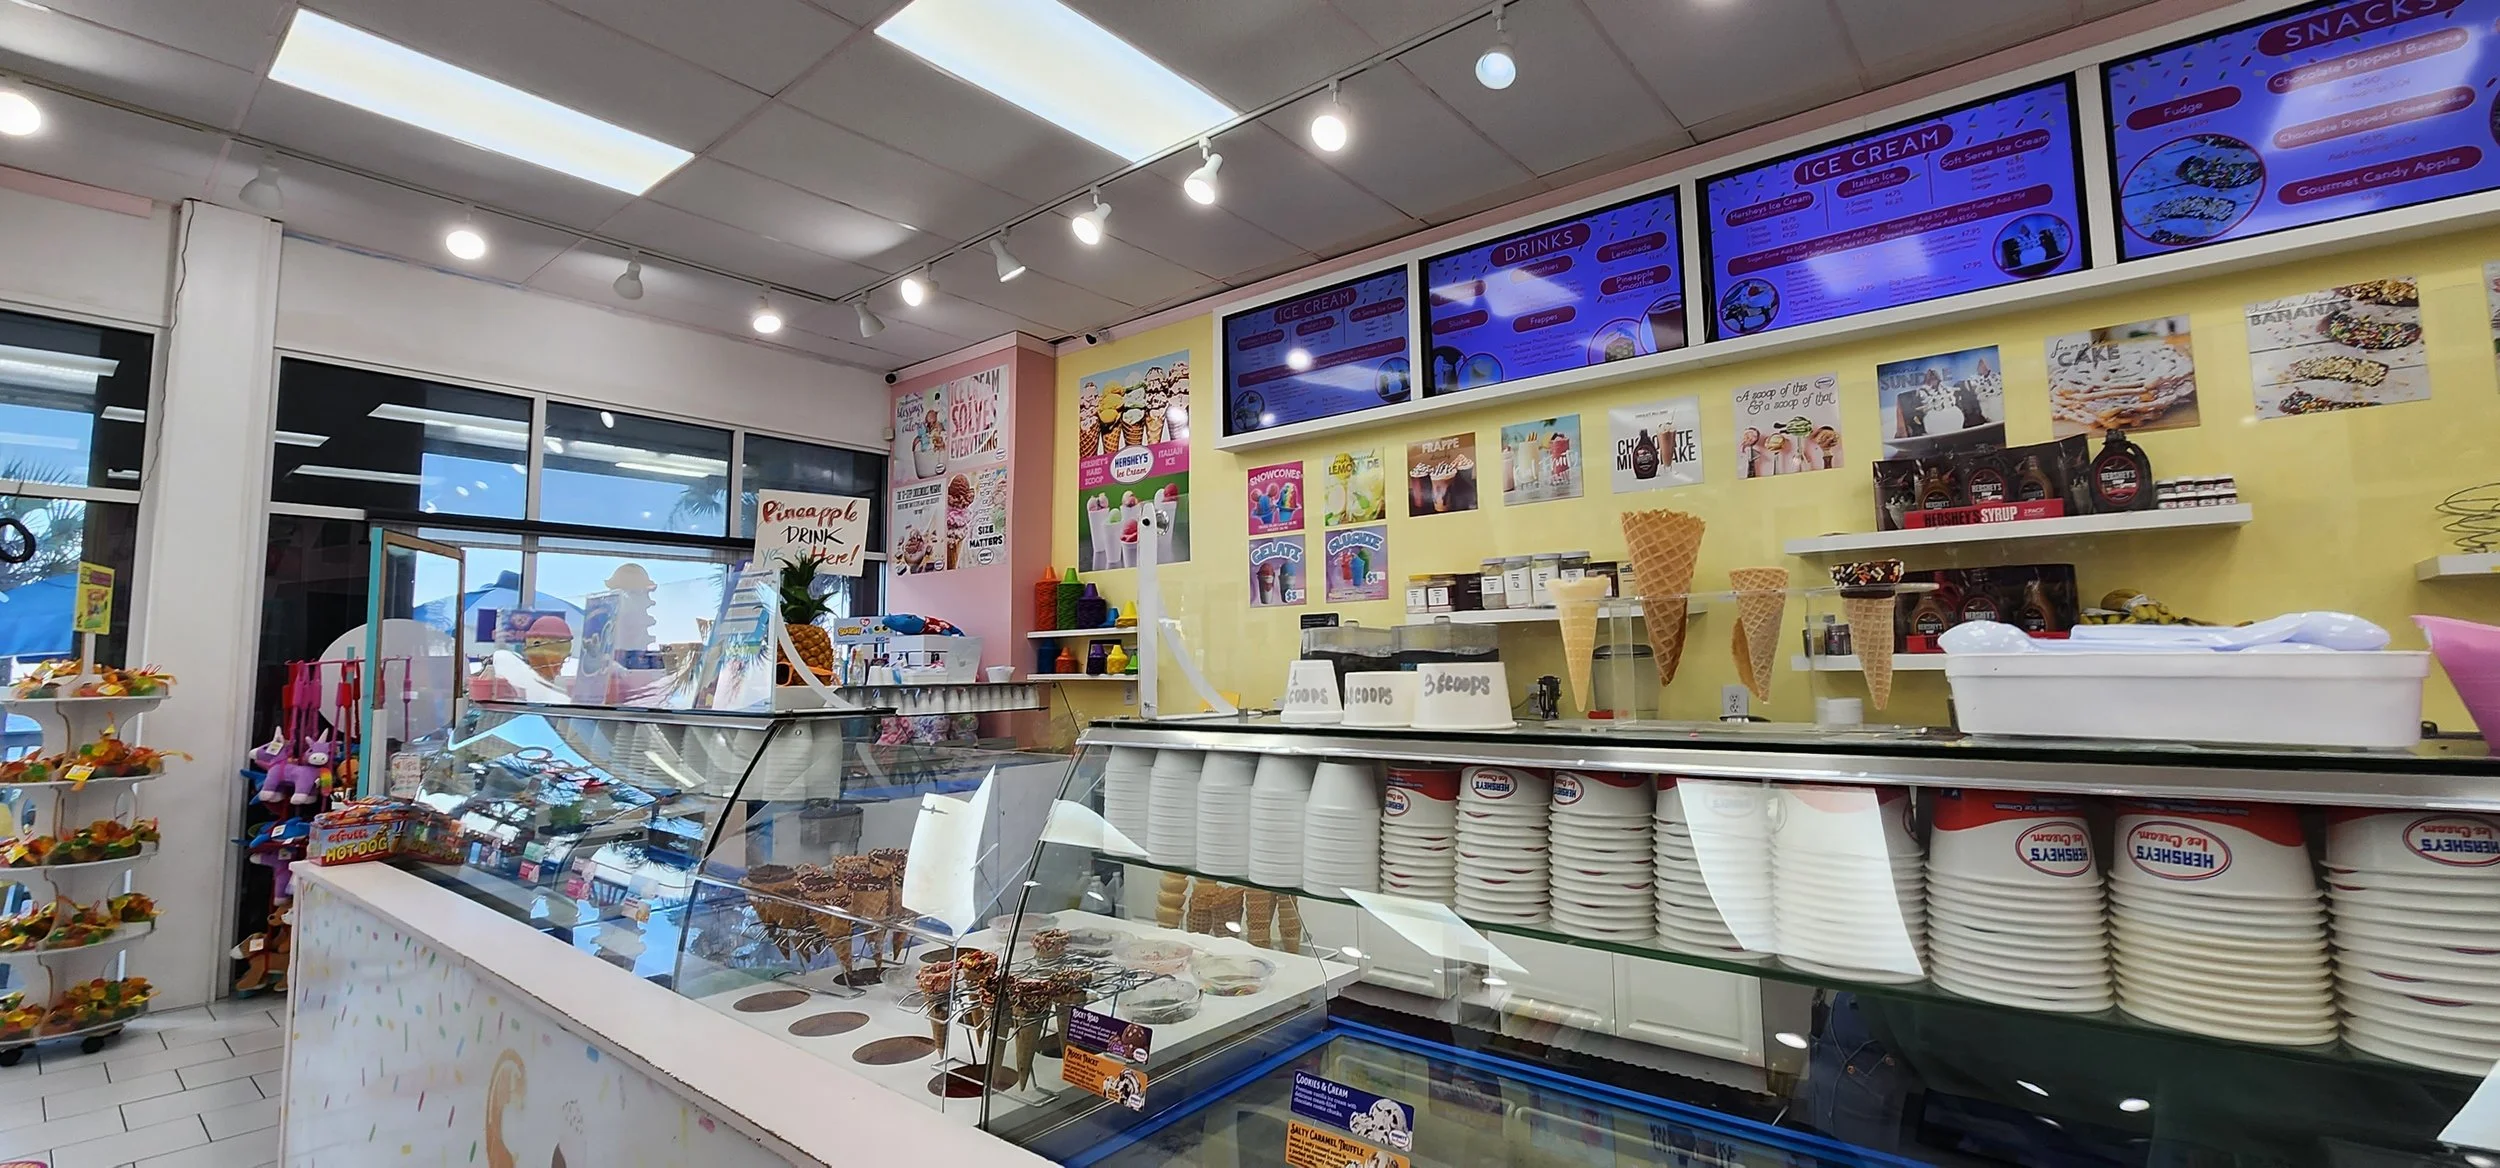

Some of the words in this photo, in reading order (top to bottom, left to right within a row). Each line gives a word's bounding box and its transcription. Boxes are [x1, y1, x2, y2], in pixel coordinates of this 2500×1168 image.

[2274, 64, 2342, 88] Chocolate
[2346, 49, 2402, 70] Dipped
[2164, 103, 2204, 117] Fudge
[2279, 124, 2338, 143] Chocolate
[2341, 111, 2388, 130] Dipped
[1804, 157, 1842, 181] ICE
[1850, 130, 1940, 169] CREAM
[1941, 155, 1962, 168] Soft
[1964, 149, 1993, 163] Serve
[1996, 143, 2012, 154] Ice
[2015, 134, 2049, 149] Cream
[1852, 177, 1880, 189] Italian
[1881, 173, 1896, 184] Ice
[2297, 177, 2359, 197] Gourmet
[2363, 166, 2408, 183] Candy
[2413, 156, 2461, 173] Apple
[1730, 207, 1767, 221] Hersheys
[1768, 200, 1782, 210] Ice
[1783, 193, 1812, 206] Cream
[1505, 230, 1574, 262] DRINKS
[1612, 243, 1652, 259] Lemonade
[1616, 270, 1655, 284] Pineapple
[1617, 279, 1654, 291] Smoothie
[1278, 306, 1299, 321] ICE
[1303, 291, 1350, 314] CREAM
[2250, 300, 2353, 326] BANANAS
[1530, 314, 1559, 326] Frappes
[2058, 344, 2121, 367] CAKE
[1880, 367, 1953, 391] SUNDE
[1736, 390, 1750, 402] A
[1752, 389, 1777, 400] scoop
[1780, 383, 1792, 398] of
[1792, 382, 1808, 396] this
[1747, 400, 1764, 415] &
[1764, 403, 1770, 411] a
[1774, 398, 1799, 410] scoop
[1802, 392, 1814, 408] of
[1815, 391, 1836, 406] that
[950, 430, 998, 459] EVERYTHING
[1421, 437, 1460, 454] FRAPPE
[1617, 429, 1694, 457] CHOTE
[1115, 453, 1149, 469] HERSHEY'S
[1165, 457, 1176, 466] ICE
[1116, 468, 1126, 479] Ice
[1126, 466, 1147, 477] Cream
[1249, 469, 1301, 487] SNOWCONES
[2100, 470, 2136, 480] HERSHEY'S
[1971, 482, 2002, 492] HERSHEY'S
[762, 499, 858, 527] Pineapple
[1924, 511, 1981, 528] HERSHEY'S
[1980, 506, 2018, 523] SYRUP
[780, 525, 844, 545] DRINK
[977, 524, 994, 536] SIZE
[969, 535, 1003, 549] MATTERS
[811, 544, 860, 566] Here!
[1251, 541, 1303, 565] GELATI
[1285, 590, 1298, 602] $5
[1964, 611, 1996, 620] HERSHEY'S
[1424, 673, 1435, 697] 3
[1475, 780, 1510, 793] HERSHEY'S
[328, 829, 369, 843] efrutti
[2031, 833, 2071, 846] Cream
[2073, 834, 2084, 846] Ice
[2137, 830, 2183, 848] Cream
[2421, 825, 2471, 838] Cream
[2474, 827, 2493, 840] Ice
[2185, 835, 2208, 852] Ice
[2421, 838, 2500, 854] HERSHEY'S
[2031, 847, 2089, 862] HERSHEY'S
[2136, 845, 2214, 869] HERSHEY'S
[1072, 1008, 1087, 1019] ROCKY
[1086, 1012, 1100, 1023] ROAD
[1067, 1048, 1083, 1060] MOOSE
[1082, 1053, 1100, 1067] TRACKS
[1296, 1073, 1320, 1090] COOKIES
[1320, 1083, 1327, 1092] &
[1327, 1082, 1349, 1099] CREAM
[1290, 1123, 1309, 1138] SALTY
[1309, 1129, 1338, 1148] CARAMEL
[1338, 1139, 1364, 1157] TRUFFLE
